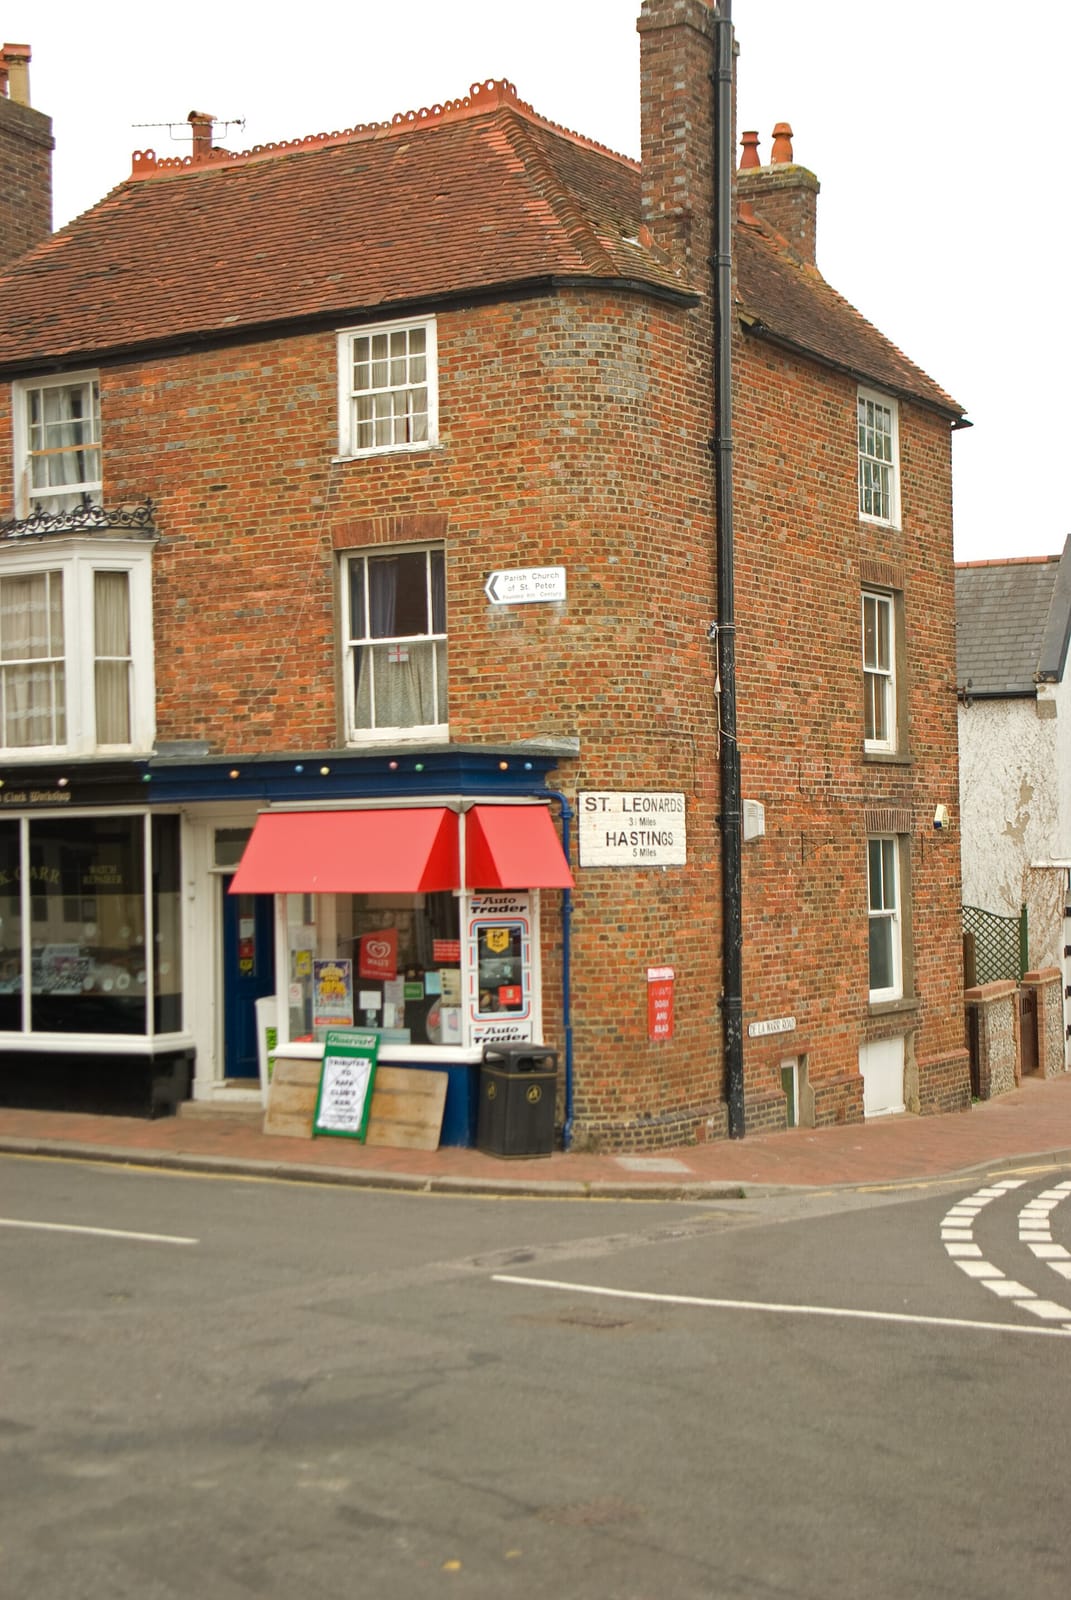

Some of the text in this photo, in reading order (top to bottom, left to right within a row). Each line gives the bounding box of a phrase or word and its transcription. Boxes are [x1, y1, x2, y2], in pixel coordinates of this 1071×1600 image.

[504, 572, 560, 582] Parish Church
[507, 582, 556, 592] of St Peter
[585, 797, 683, 813] ST. LEONARDS
[639, 817, 656, 826] Miles
[606, 831, 674, 847] HASTINGS
[632, 848, 657, 858] 5 Miles
[483, 896, 517, 905] Auto
[470, 905, 527, 914] Trader
[485, 1026, 519, 1034] Auto
[473, 1034, 528, 1044] Trader
